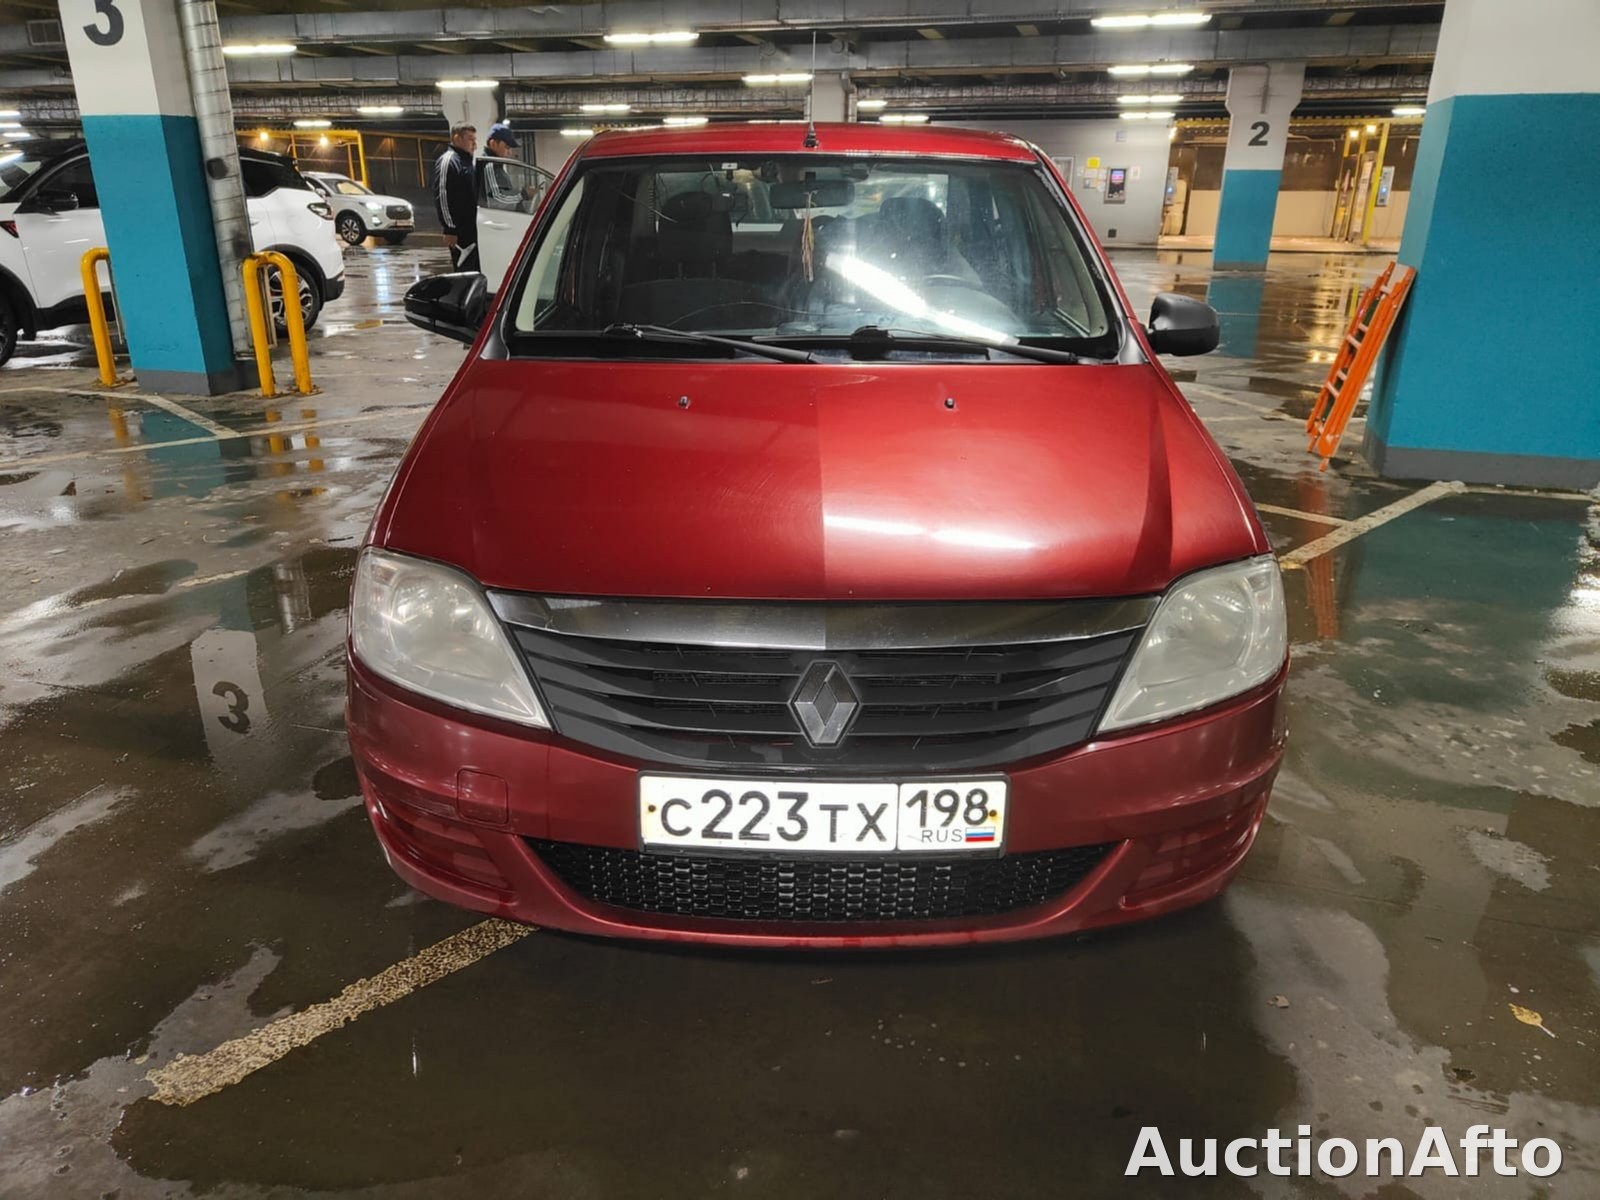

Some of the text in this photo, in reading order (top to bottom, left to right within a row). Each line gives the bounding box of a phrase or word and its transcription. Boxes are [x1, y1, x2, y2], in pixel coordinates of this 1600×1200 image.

[1248, 121, 1270, 146] 2
[906, 788, 988, 828] 198
[921, 829, 963, 843] RUS
